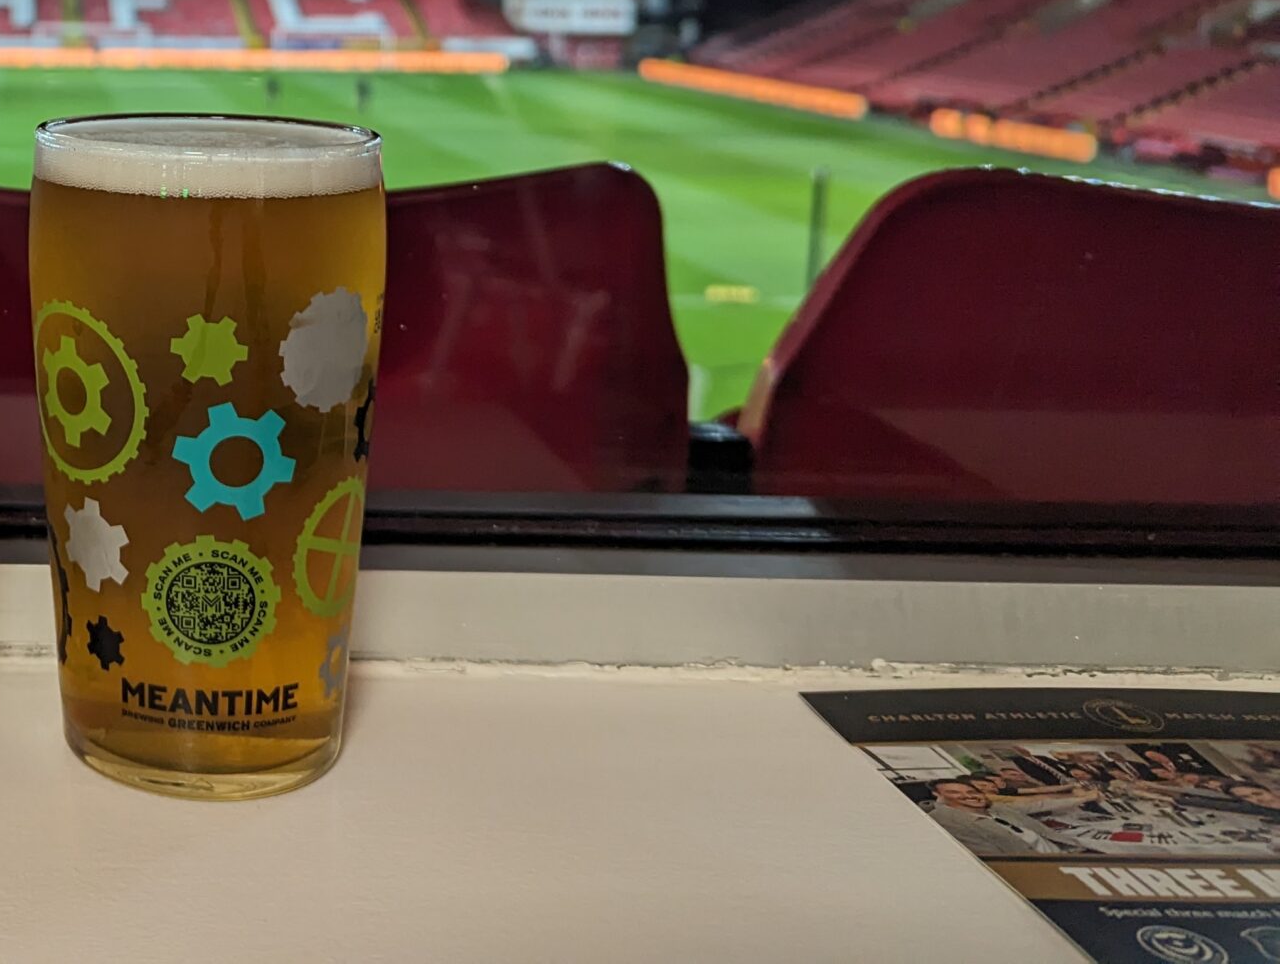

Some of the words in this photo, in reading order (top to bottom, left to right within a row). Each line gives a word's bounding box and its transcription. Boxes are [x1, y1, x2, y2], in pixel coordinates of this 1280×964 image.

[153, 566, 173, 600] SCAN
[172, 553, 192, 568] ME
[211, 549, 248, 567] SCAN
[248, 566, 264, 585] ME
[158, 617, 174, 636] ME
[249, 600, 268, 636] SCAN
[173, 637, 212, 657] SCAN
[229, 636, 250, 652] ME
[121, 677, 300, 717] MEANTIME
[168, 717, 251, 733] GREENWICH
[253, 714, 298, 729] COMPANY
[867, 712, 977, 722] CHARLTON
[984, 711, 1083, 721] ATHLETIC
[1058, 866, 1256, 898] THREE
[1098, 906, 1163, 919] Special
[1164, 908, 1210, 918] three
